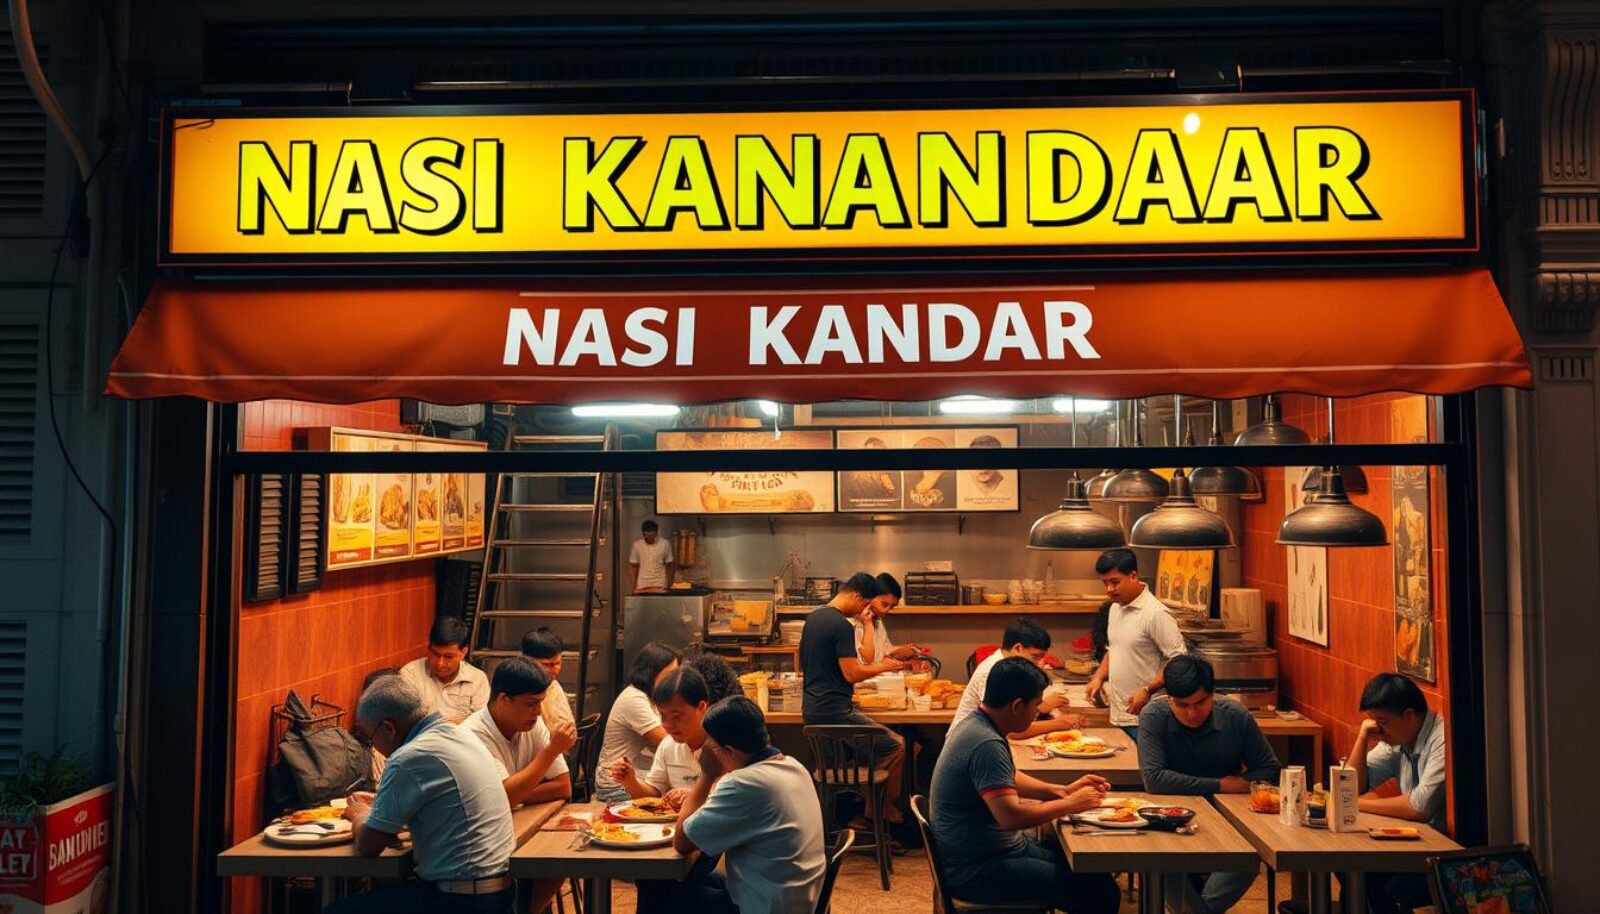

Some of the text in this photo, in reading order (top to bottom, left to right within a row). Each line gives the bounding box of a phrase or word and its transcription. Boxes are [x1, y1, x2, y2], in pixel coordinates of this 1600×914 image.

[238, 138, 504, 235] NASI
[503, 301, 1101, 367] NASI KANDAR
